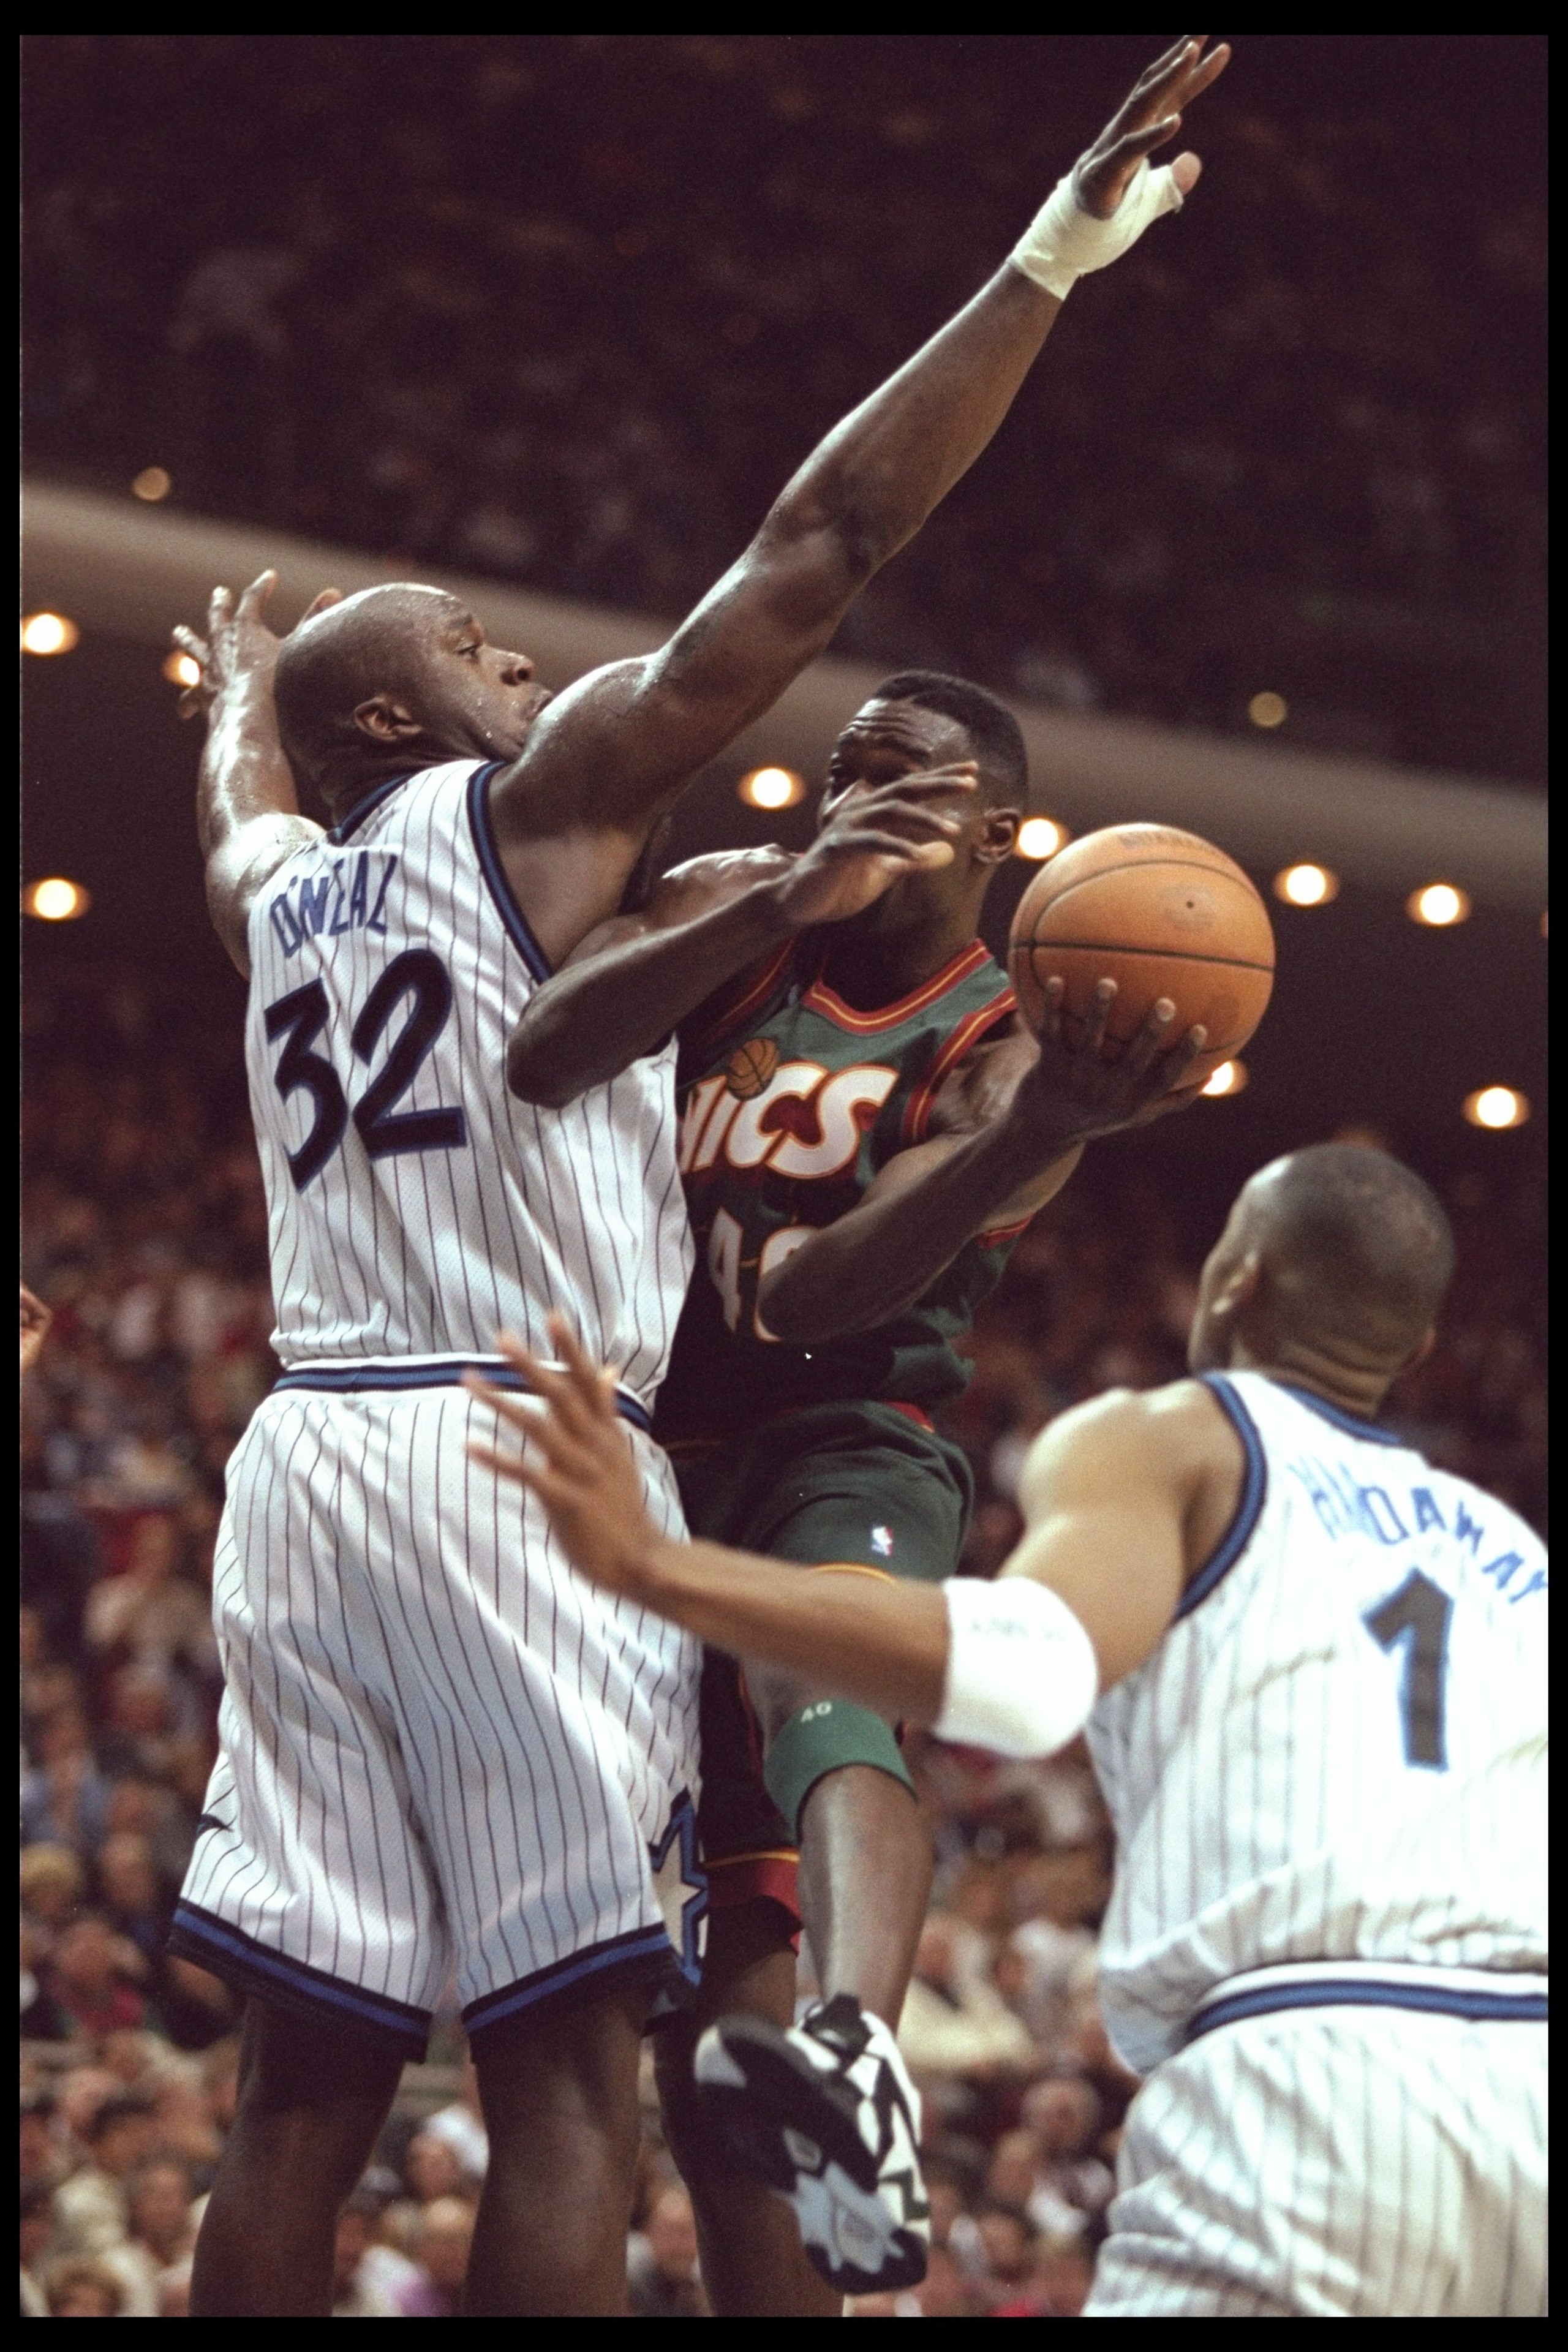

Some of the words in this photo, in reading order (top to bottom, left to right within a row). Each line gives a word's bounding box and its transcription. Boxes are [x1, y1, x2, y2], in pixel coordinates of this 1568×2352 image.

[270, 850, 397, 959] O'NEAL
[264, 948, 467, 1194] 32
[801, 1701, 832, 1724] 40
[1360, 1566, 1454, 1773] 1
